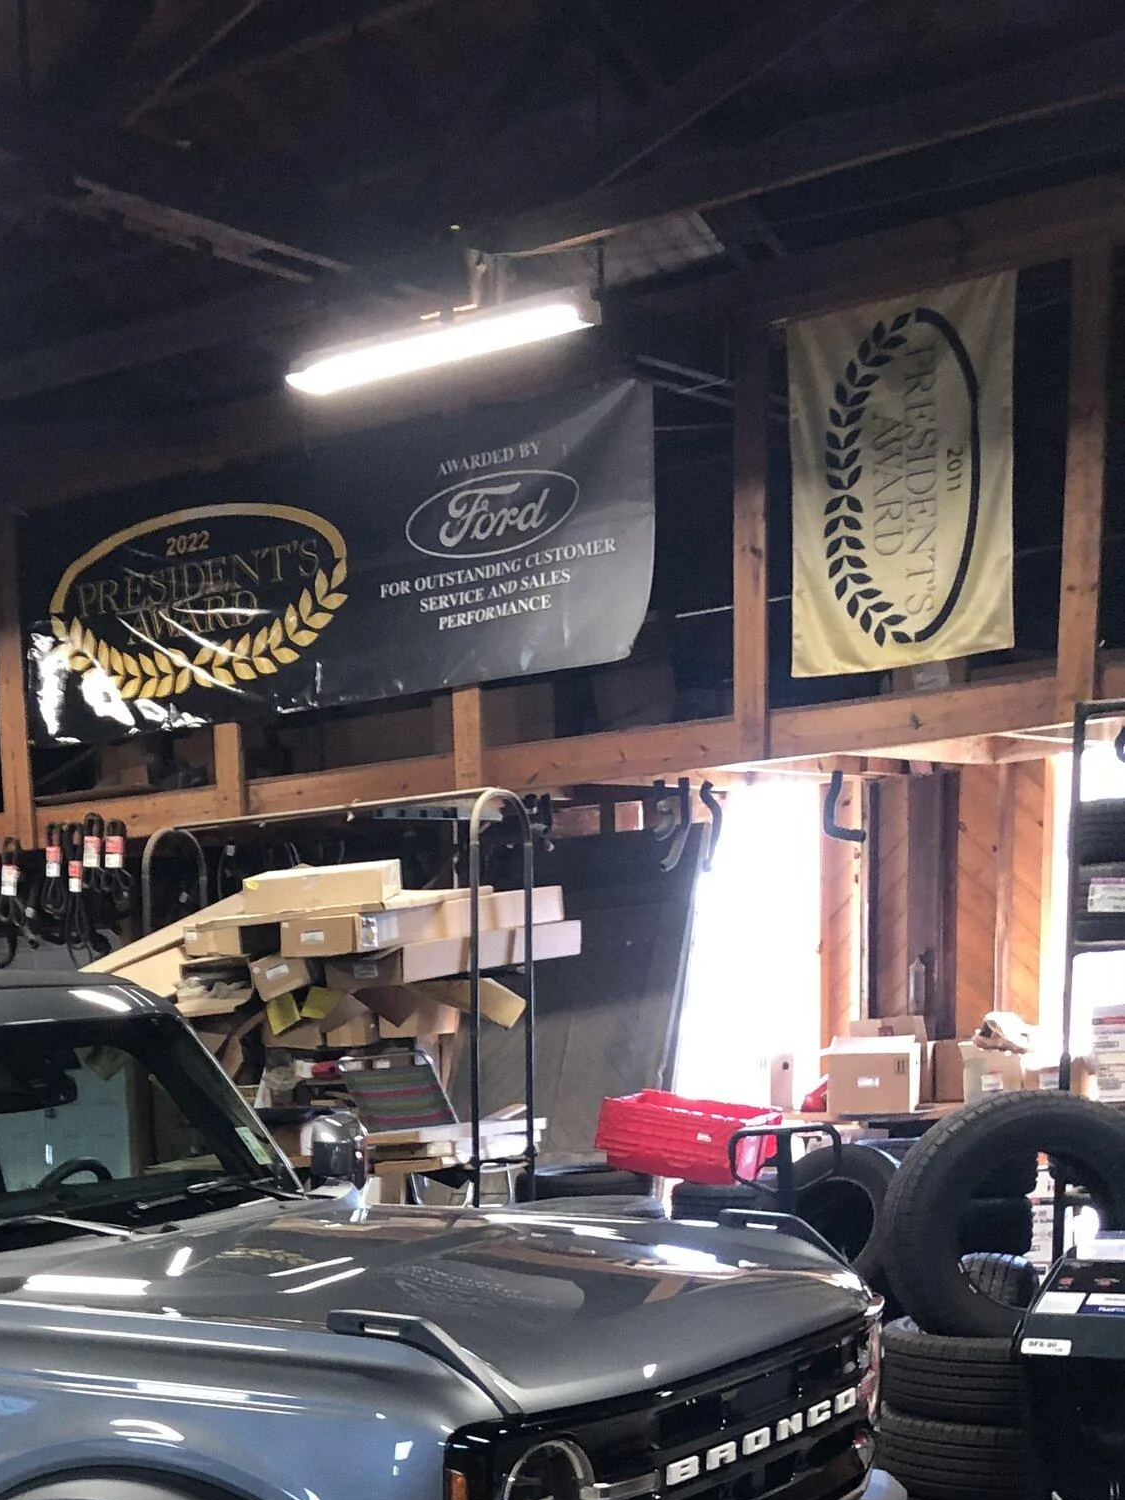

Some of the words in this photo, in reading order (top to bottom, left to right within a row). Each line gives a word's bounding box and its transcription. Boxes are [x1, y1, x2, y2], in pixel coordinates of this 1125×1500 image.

[436, 447, 514, 478] AWARDED
[519, 440, 542, 460] BY
[873, 413, 904, 556] AWARD
[904, 341, 937, 616] PRESIDENT'S
[946, 446, 963, 492] 2011
[166, 530, 210, 556] 2022
[438, 482, 551, 548] Ford
[75, 538, 321, 618] PRESIDENT'S
[380, 578, 411, 598] FOR
[414, 558, 521, 593] OUTSTANDING
[524, 537, 616, 569] CUSTOMER
[419, 587, 484, 613] SERVICE
[487, 578, 518, 600] AND
[520, 568, 571, 592] SALES
[127, 589, 259, 645] AWARD
[438, 594, 552, 631] PERFORMANCE
[666, 1386, 857, 1487] BRONCO
